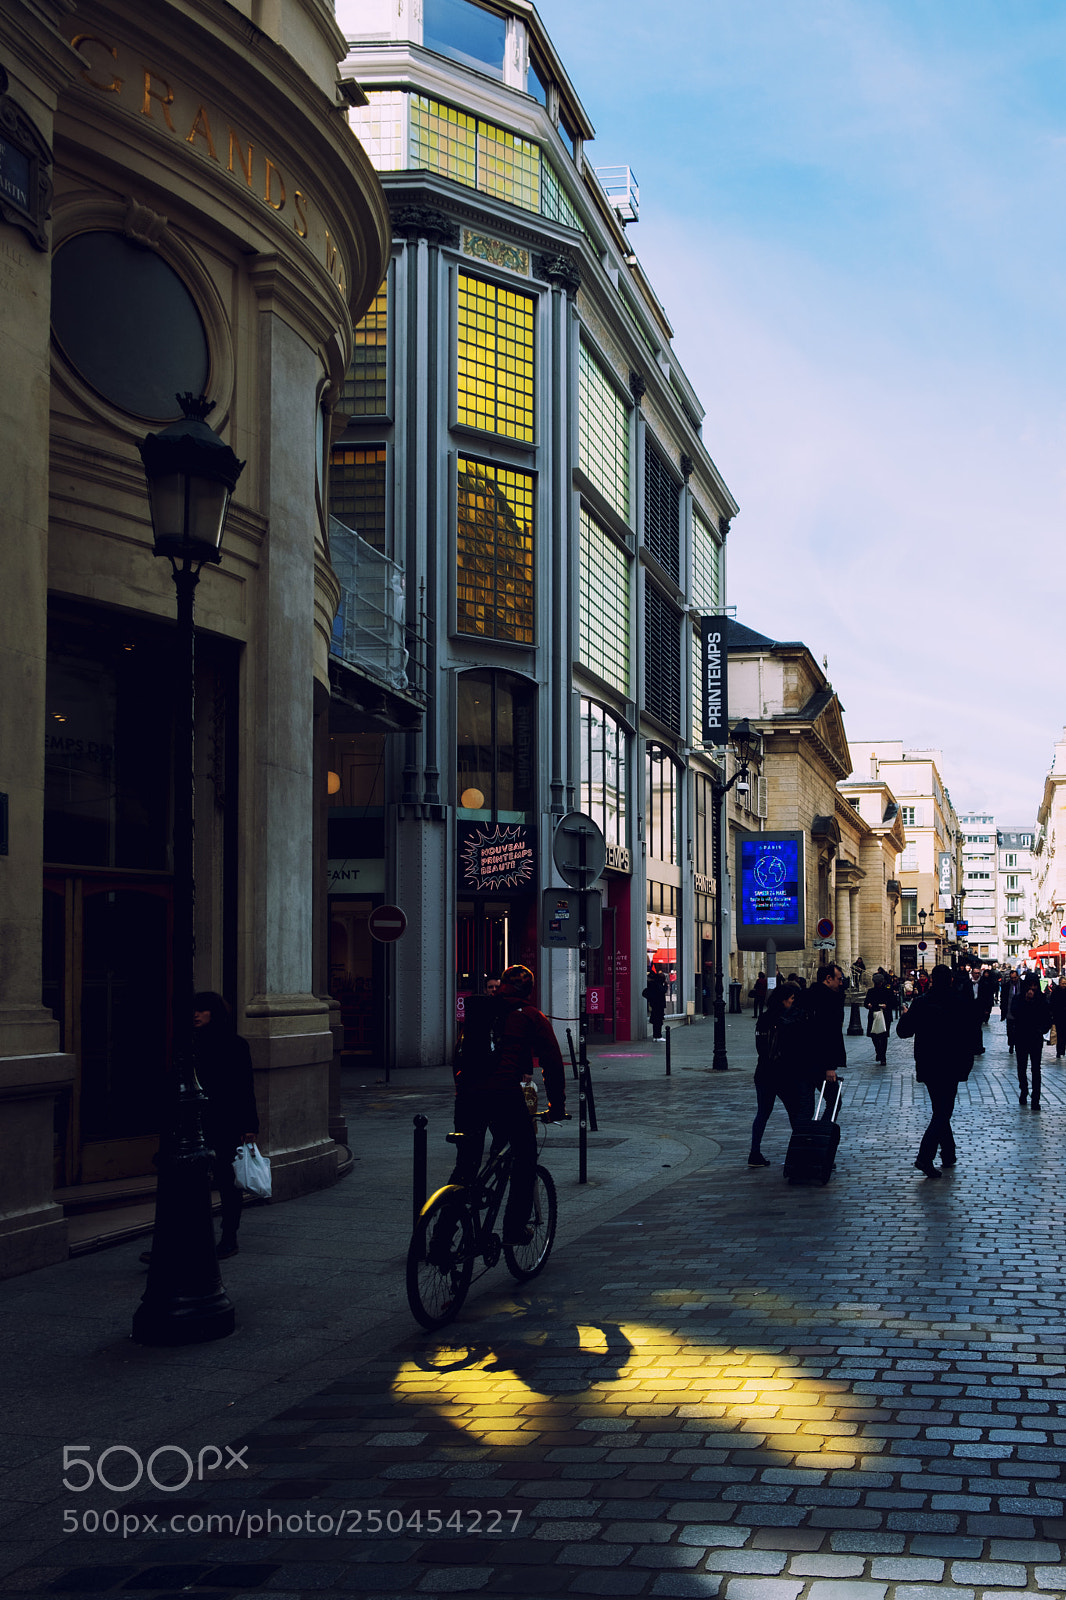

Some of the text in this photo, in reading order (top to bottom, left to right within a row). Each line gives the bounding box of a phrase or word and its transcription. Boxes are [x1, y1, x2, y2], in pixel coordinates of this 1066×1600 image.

[71, 33, 308, 239] GRANDS
[707, 632, 722, 728] PRINTEMPS
[481, 841, 526, 857] NOUVEAU
[481, 848, 533, 867] PRINTEMPS
[940, 857, 951, 890] fnac
[456, 997, 465, 1011] 8
[590, 991, 599, 1004] 8
